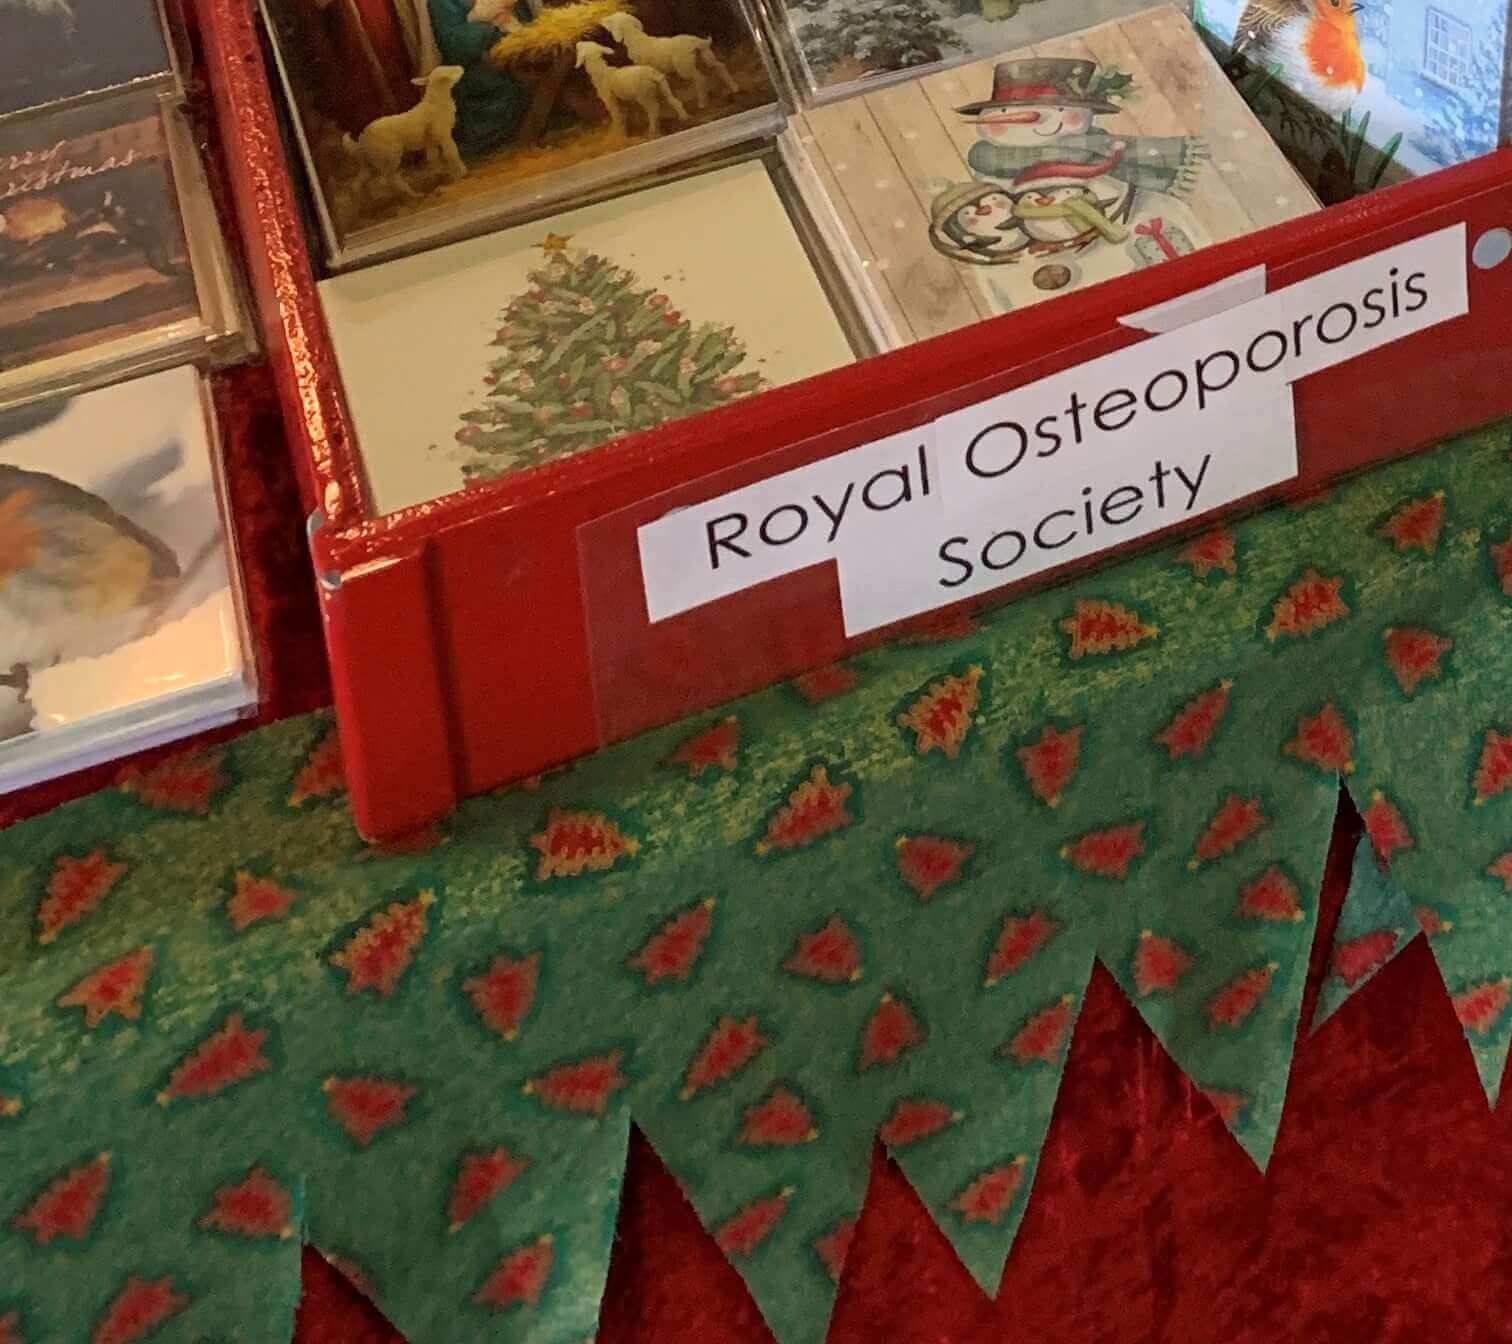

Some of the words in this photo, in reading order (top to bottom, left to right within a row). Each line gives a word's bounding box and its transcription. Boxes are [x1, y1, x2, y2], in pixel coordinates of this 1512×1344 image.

[706, 444, 931, 569] Royal
[964, 266, 1430, 481] Osteoporosis
[937, 453, 1213, 588] Society
